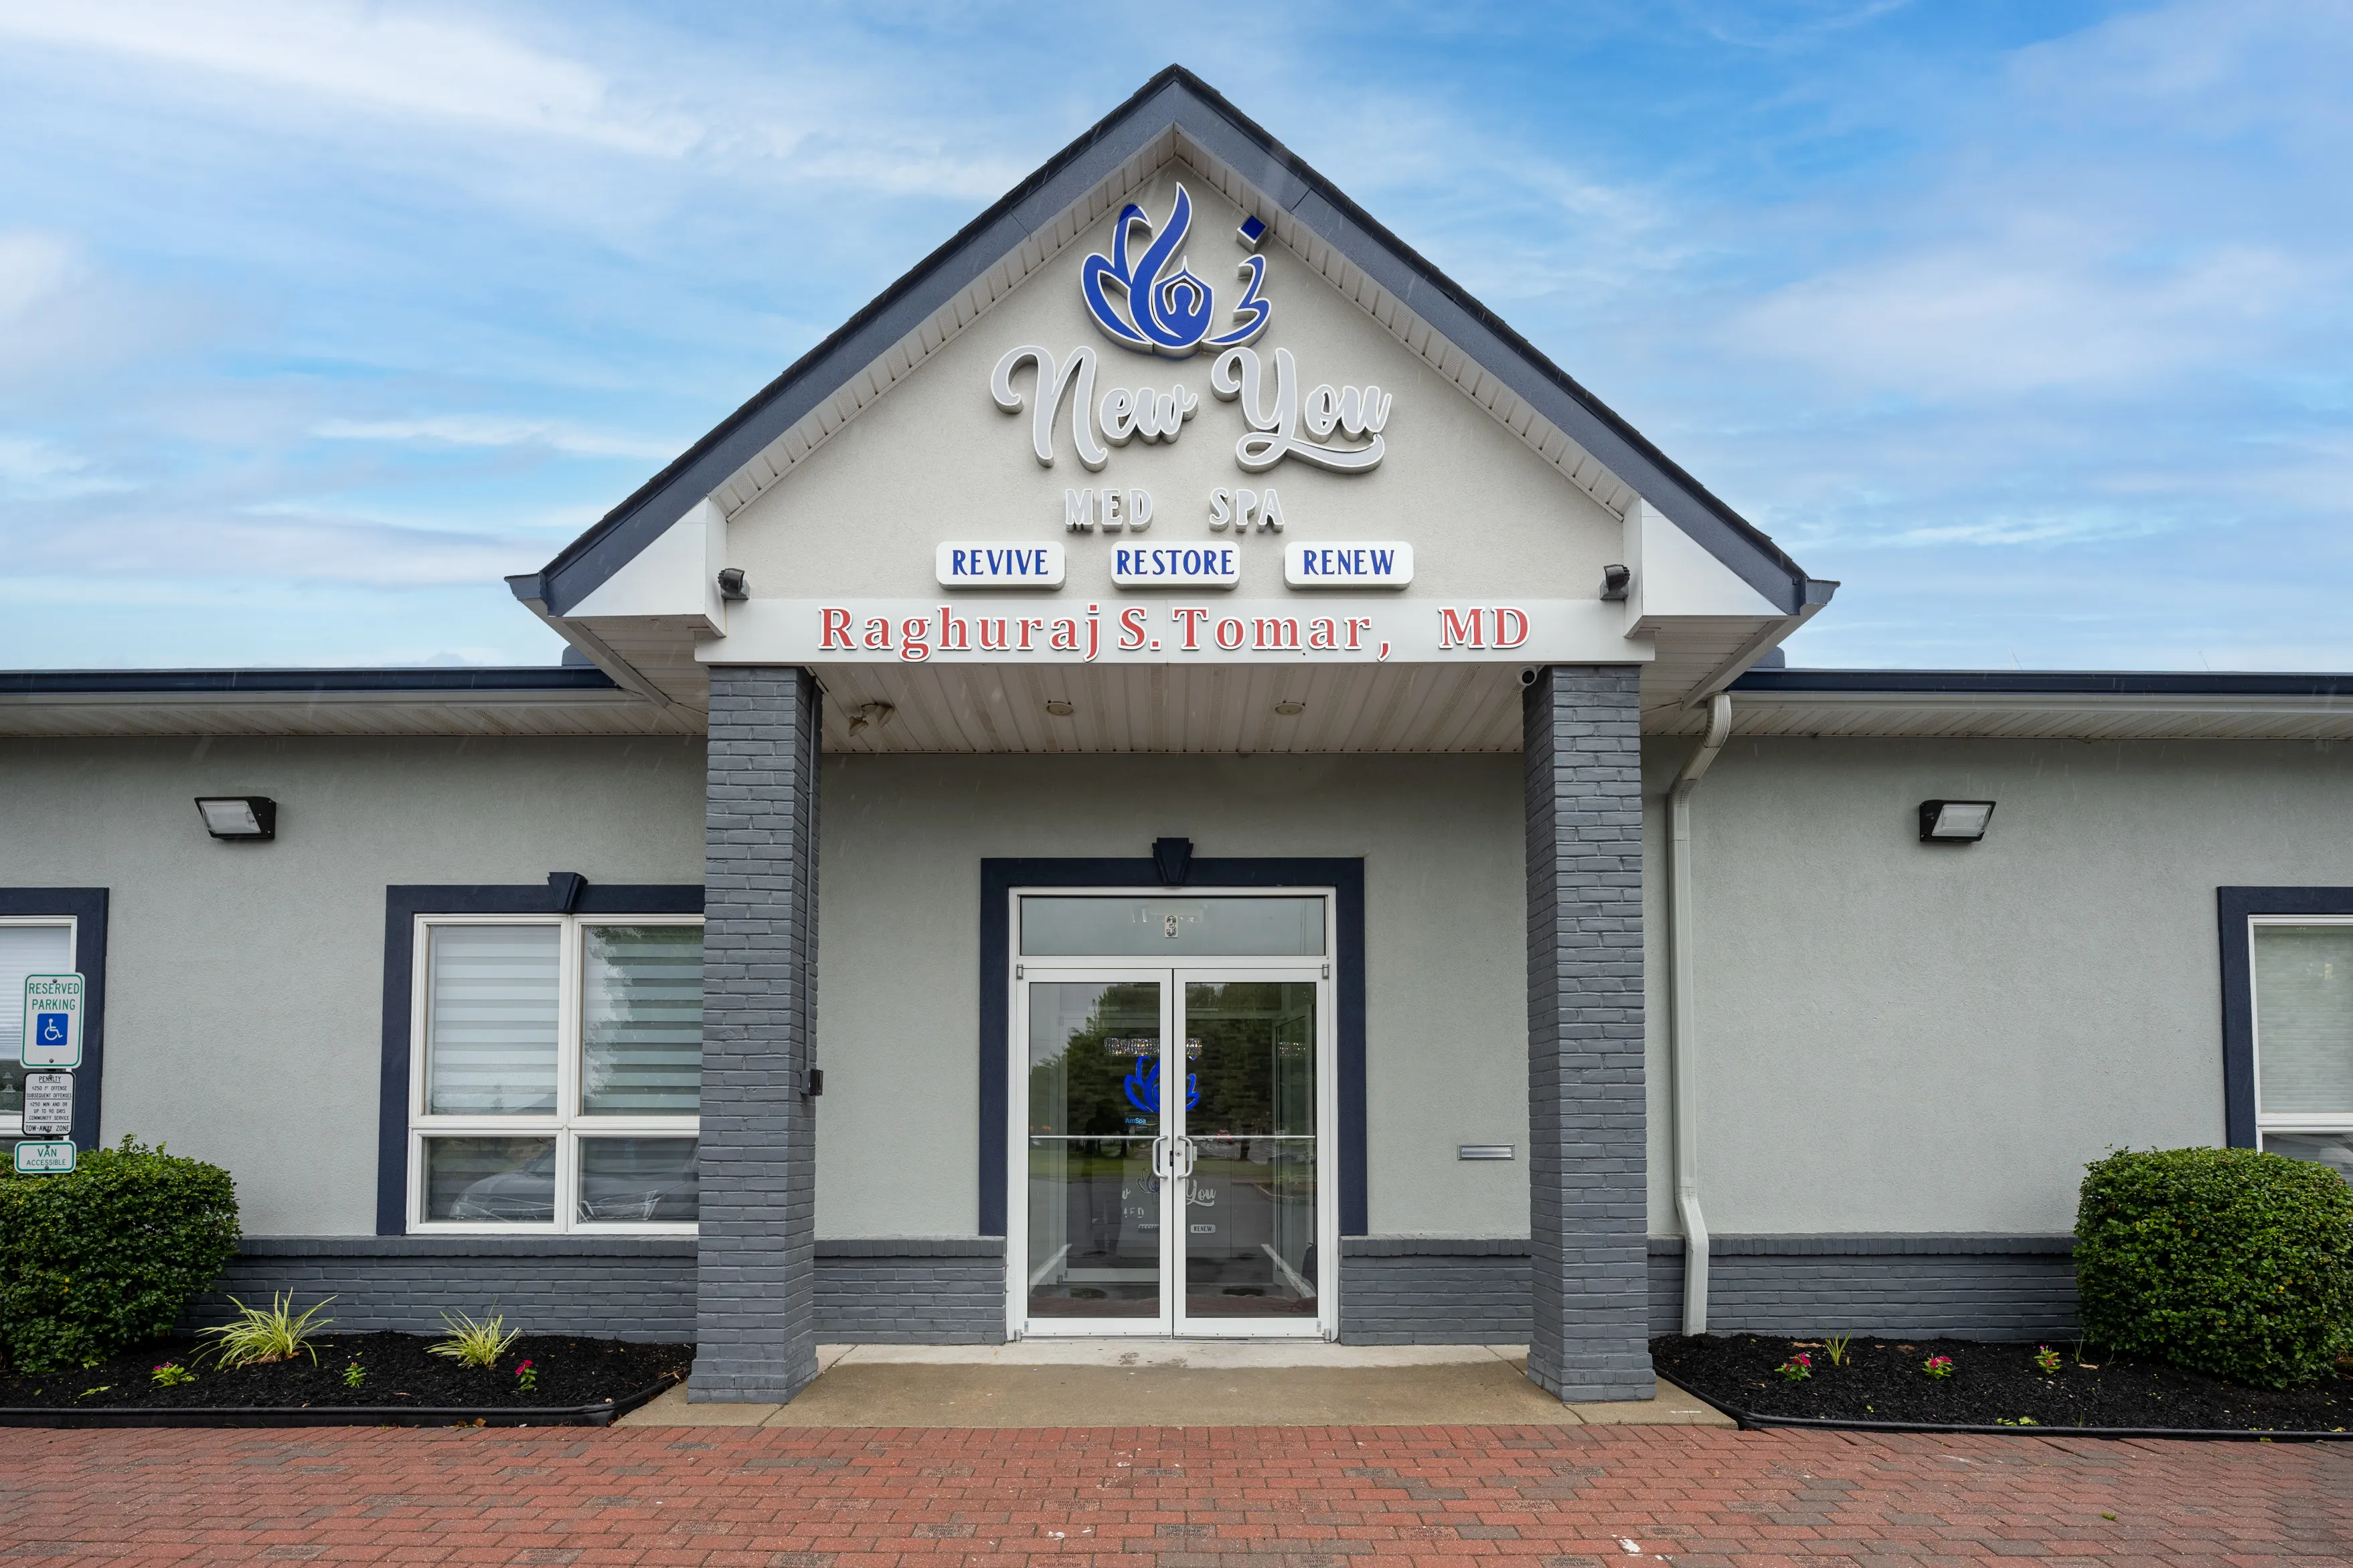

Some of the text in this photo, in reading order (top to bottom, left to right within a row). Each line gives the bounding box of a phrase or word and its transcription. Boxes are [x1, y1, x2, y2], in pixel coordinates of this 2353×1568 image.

[991, 345, 1392, 472] New You
[1065, 488, 1285, 531] MED SPA
[953, 549, 1047, 576] REVIVE
[1117, 550, 1233, 576] RESTORE
[1304, 550, 1393, 576] RENEW
[818, 602, 1532, 662] Raghuraj S. Tomar, MD
[1166, 915, 1177, 937] 3
[29, 983, 80, 994] RESERVED
[31, 999, 76, 1011] PARKING
[37, 1148, 57, 1157] VAN
